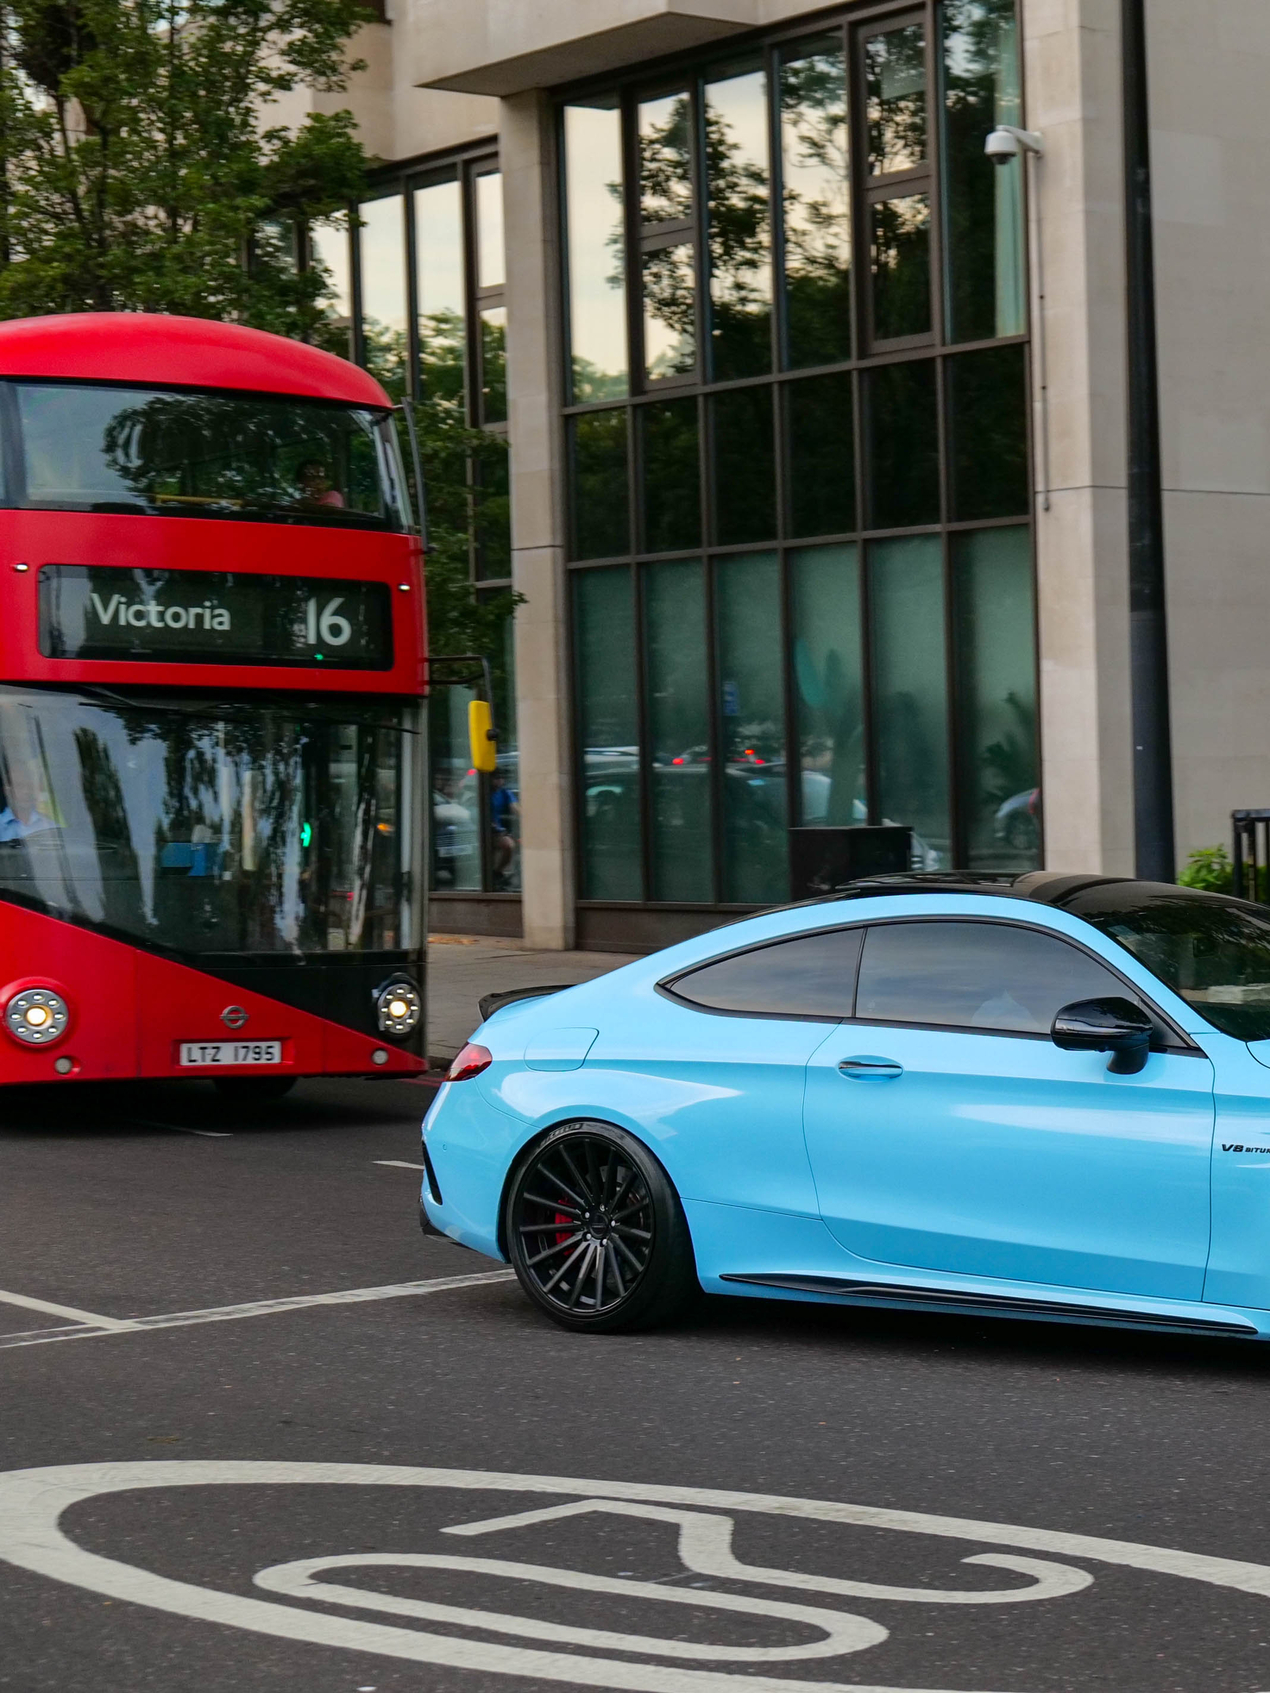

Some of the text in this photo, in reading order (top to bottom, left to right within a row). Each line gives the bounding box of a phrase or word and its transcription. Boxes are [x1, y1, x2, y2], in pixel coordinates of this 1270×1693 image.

[90, 593, 352, 646] Victoria 16
[187, 1045, 275, 1063] LTZ 1795
[1222, 1143, 1244, 1153] V8
